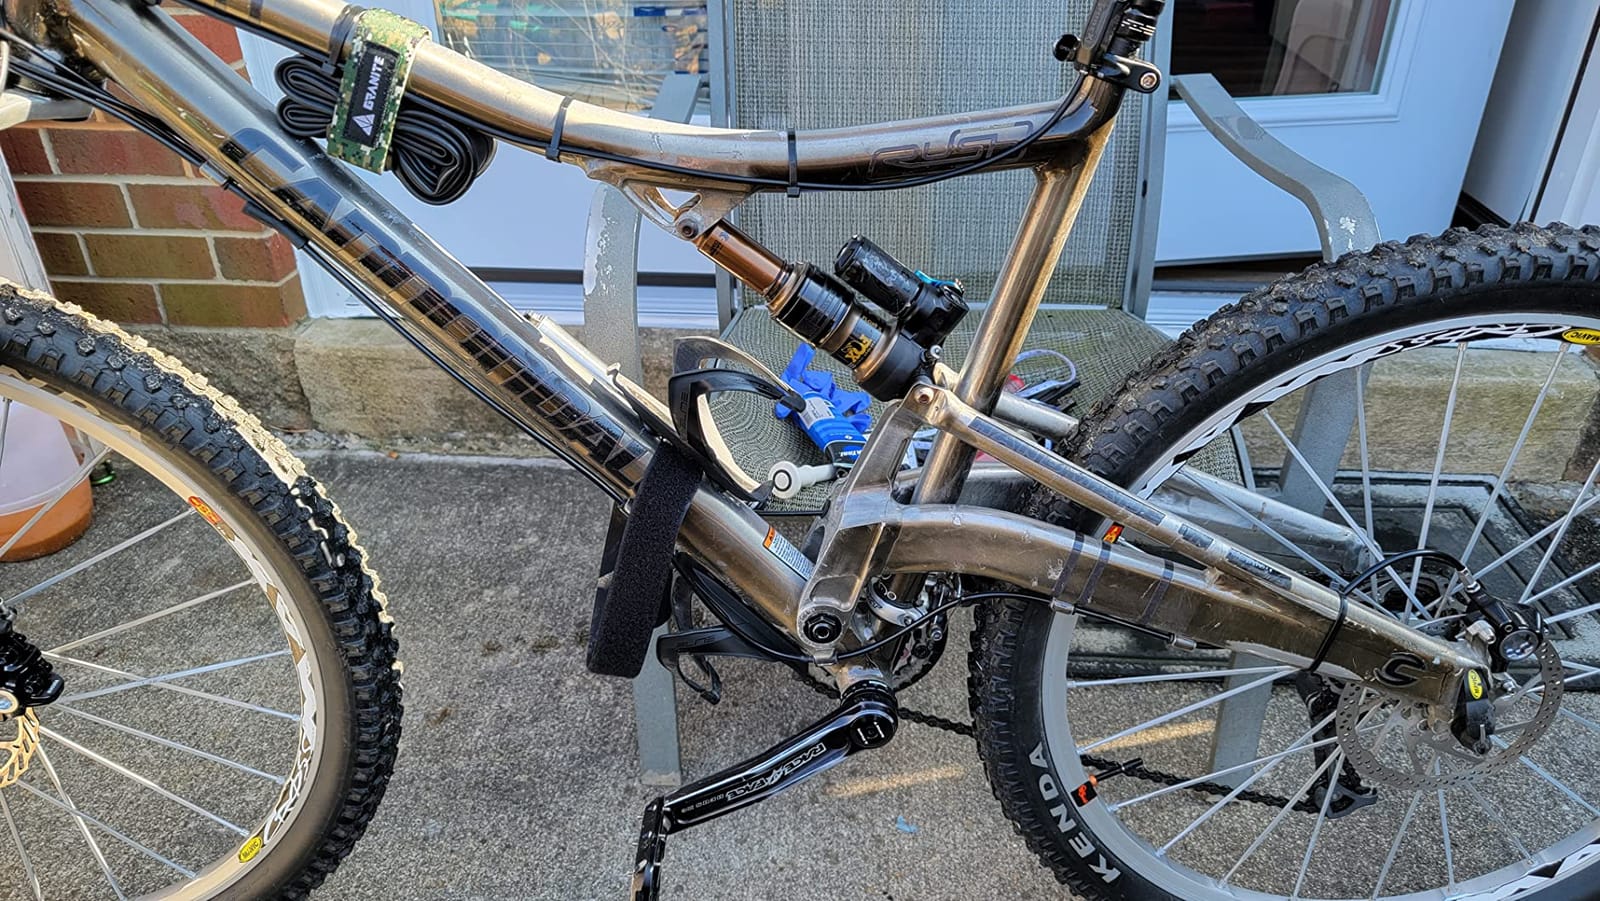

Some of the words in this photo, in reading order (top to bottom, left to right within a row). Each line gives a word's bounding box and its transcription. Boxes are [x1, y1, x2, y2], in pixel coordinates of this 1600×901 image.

[362, 55, 385, 111] GRANITE
[218, 126, 649, 490] CANNONDAL
[842, 334, 874, 365] FOX
[784, 742, 827, 776] RACE
[724, 777, 768, 801] FACE
[1028, 741, 1121, 884] KENDA
